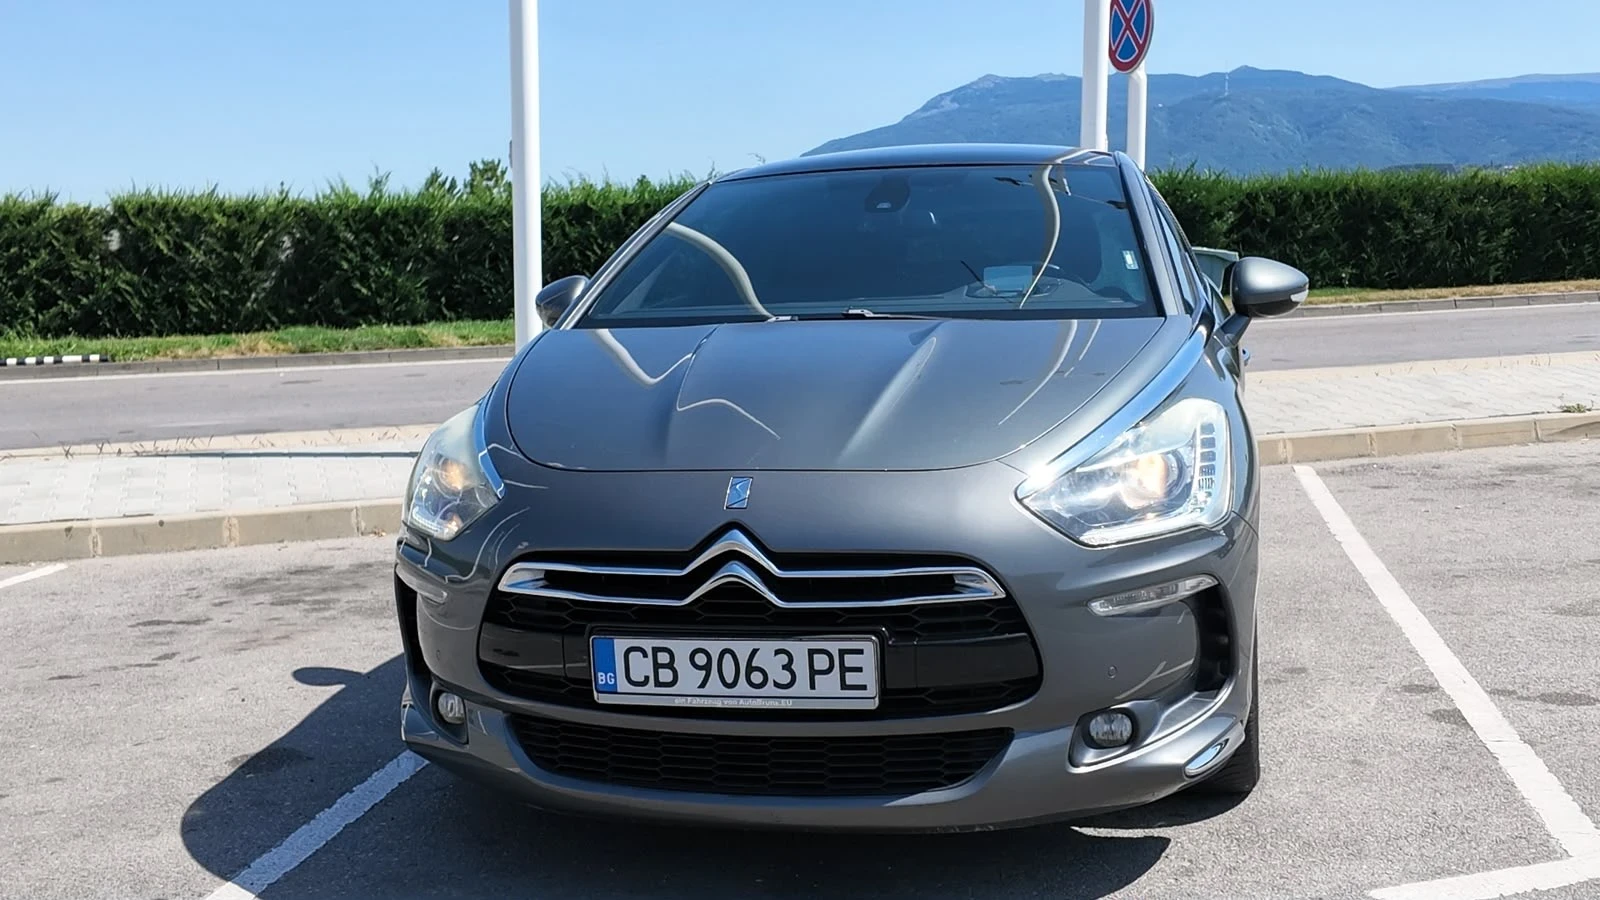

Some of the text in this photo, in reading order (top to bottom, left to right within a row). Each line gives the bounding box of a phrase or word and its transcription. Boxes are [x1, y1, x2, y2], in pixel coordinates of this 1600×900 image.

[597, 672, 615, 685] BG
[623, 645, 868, 691] CB 9063 PE
